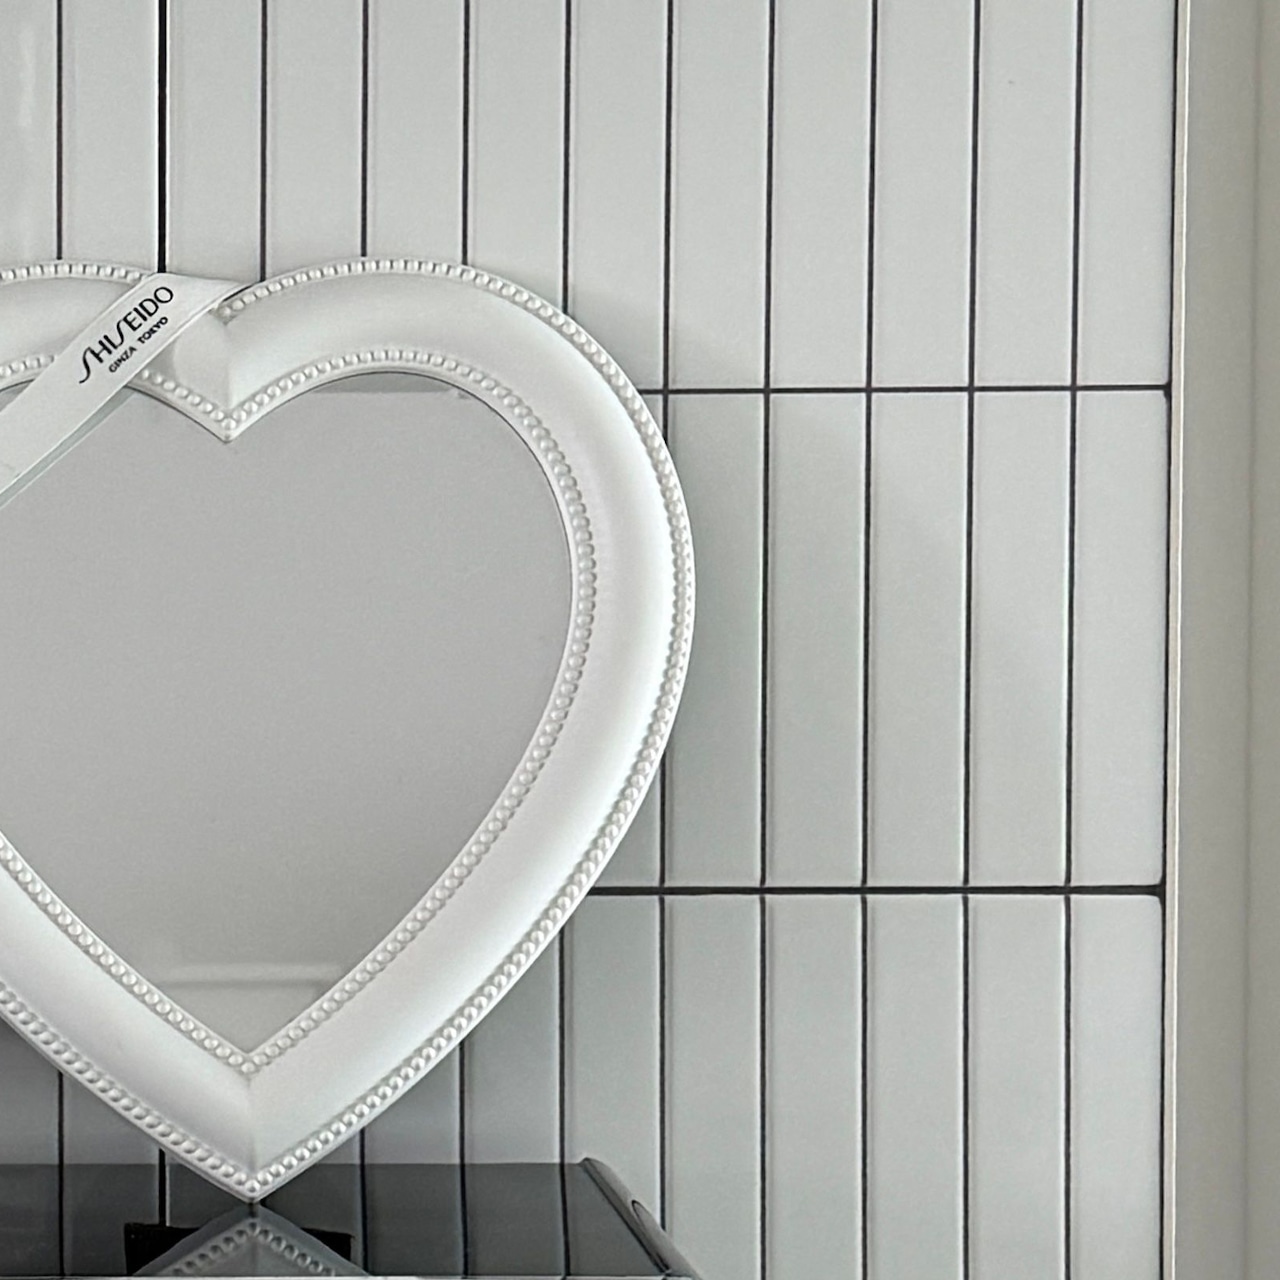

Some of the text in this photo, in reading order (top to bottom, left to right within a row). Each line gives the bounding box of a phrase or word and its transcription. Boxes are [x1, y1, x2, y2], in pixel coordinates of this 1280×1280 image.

[79, 286, 174, 384] SHISEIDO
[108, 316, 168, 373] GINZA TOKYO
